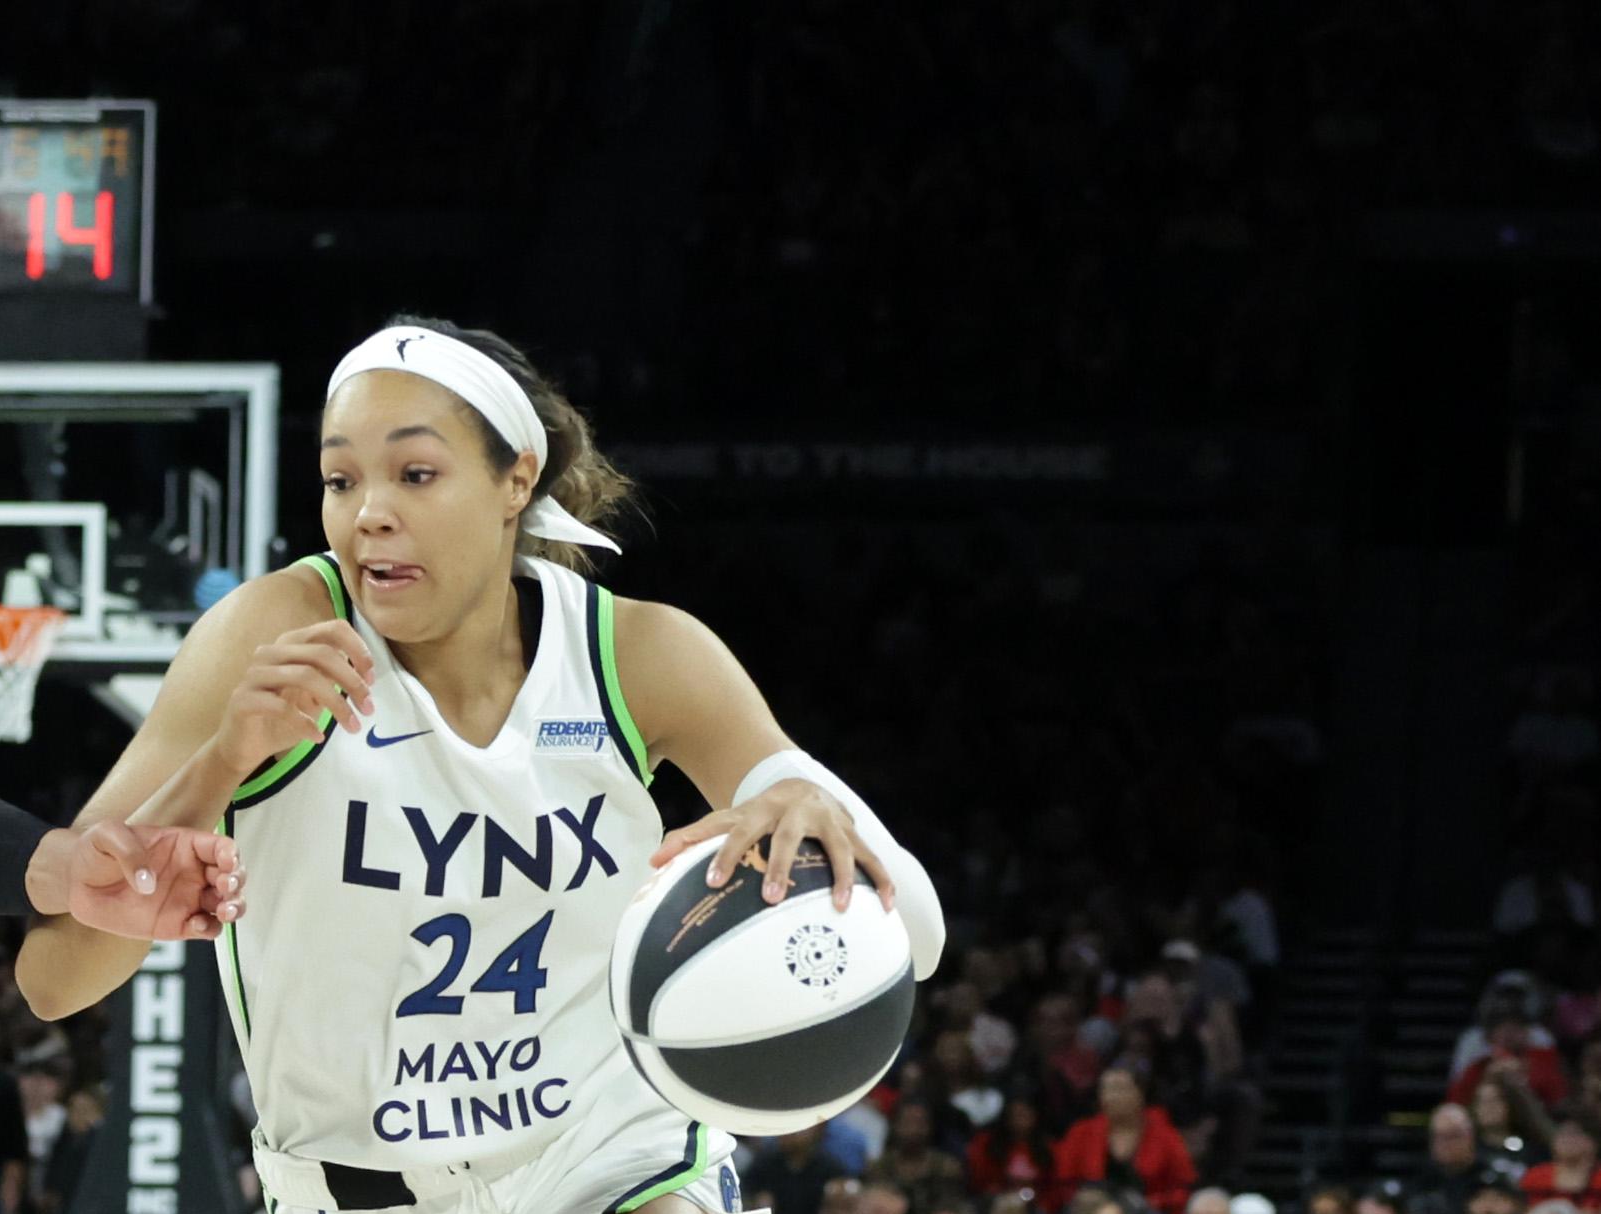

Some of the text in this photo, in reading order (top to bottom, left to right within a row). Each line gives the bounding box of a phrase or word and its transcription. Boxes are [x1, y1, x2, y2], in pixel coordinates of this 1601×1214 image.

[25, 191, 115, 281] 14
[811, 444, 917, 480] THE
[535, 735, 594, 748] INSURANCE
[539, 721, 610, 737] FEDERATE
[342, 792, 620, 899] LYNX
[395, 909, 556, 1019] 24
[394, 1034, 541, 1087] MAYO
[372, 1077, 572, 1143] CLINIC
